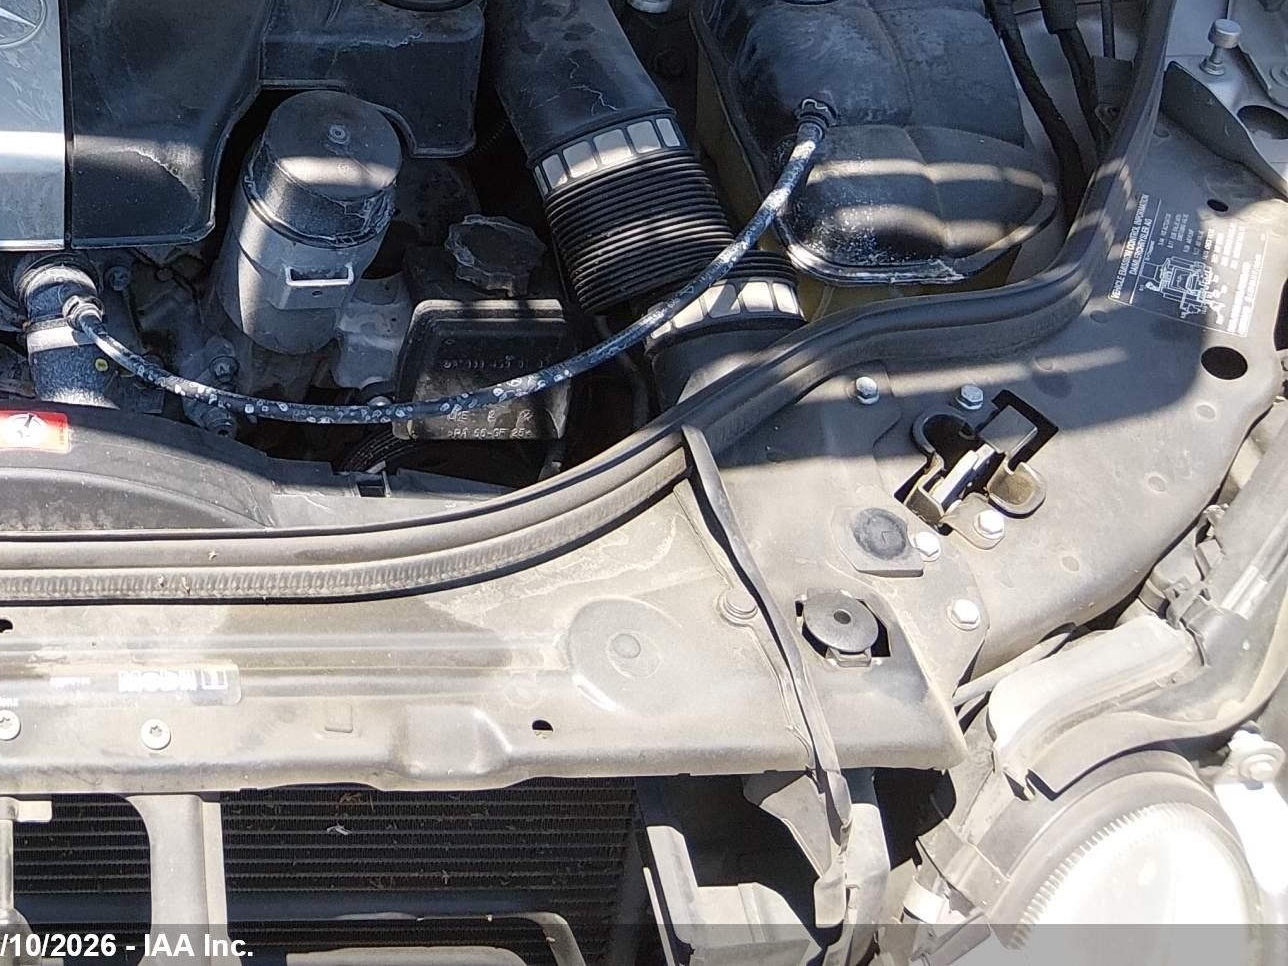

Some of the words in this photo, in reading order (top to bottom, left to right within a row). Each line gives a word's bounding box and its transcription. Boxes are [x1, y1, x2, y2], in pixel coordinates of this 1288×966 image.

[1110, 275, 1125, 299] VEHICLE
[1118, 249, 1132, 276] EMISSION
[1126, 225, 1140, 250] CONTROL
[1133, 193, 1149, 226] INFORMATION
[1143, 218, 1152, 227] AG
